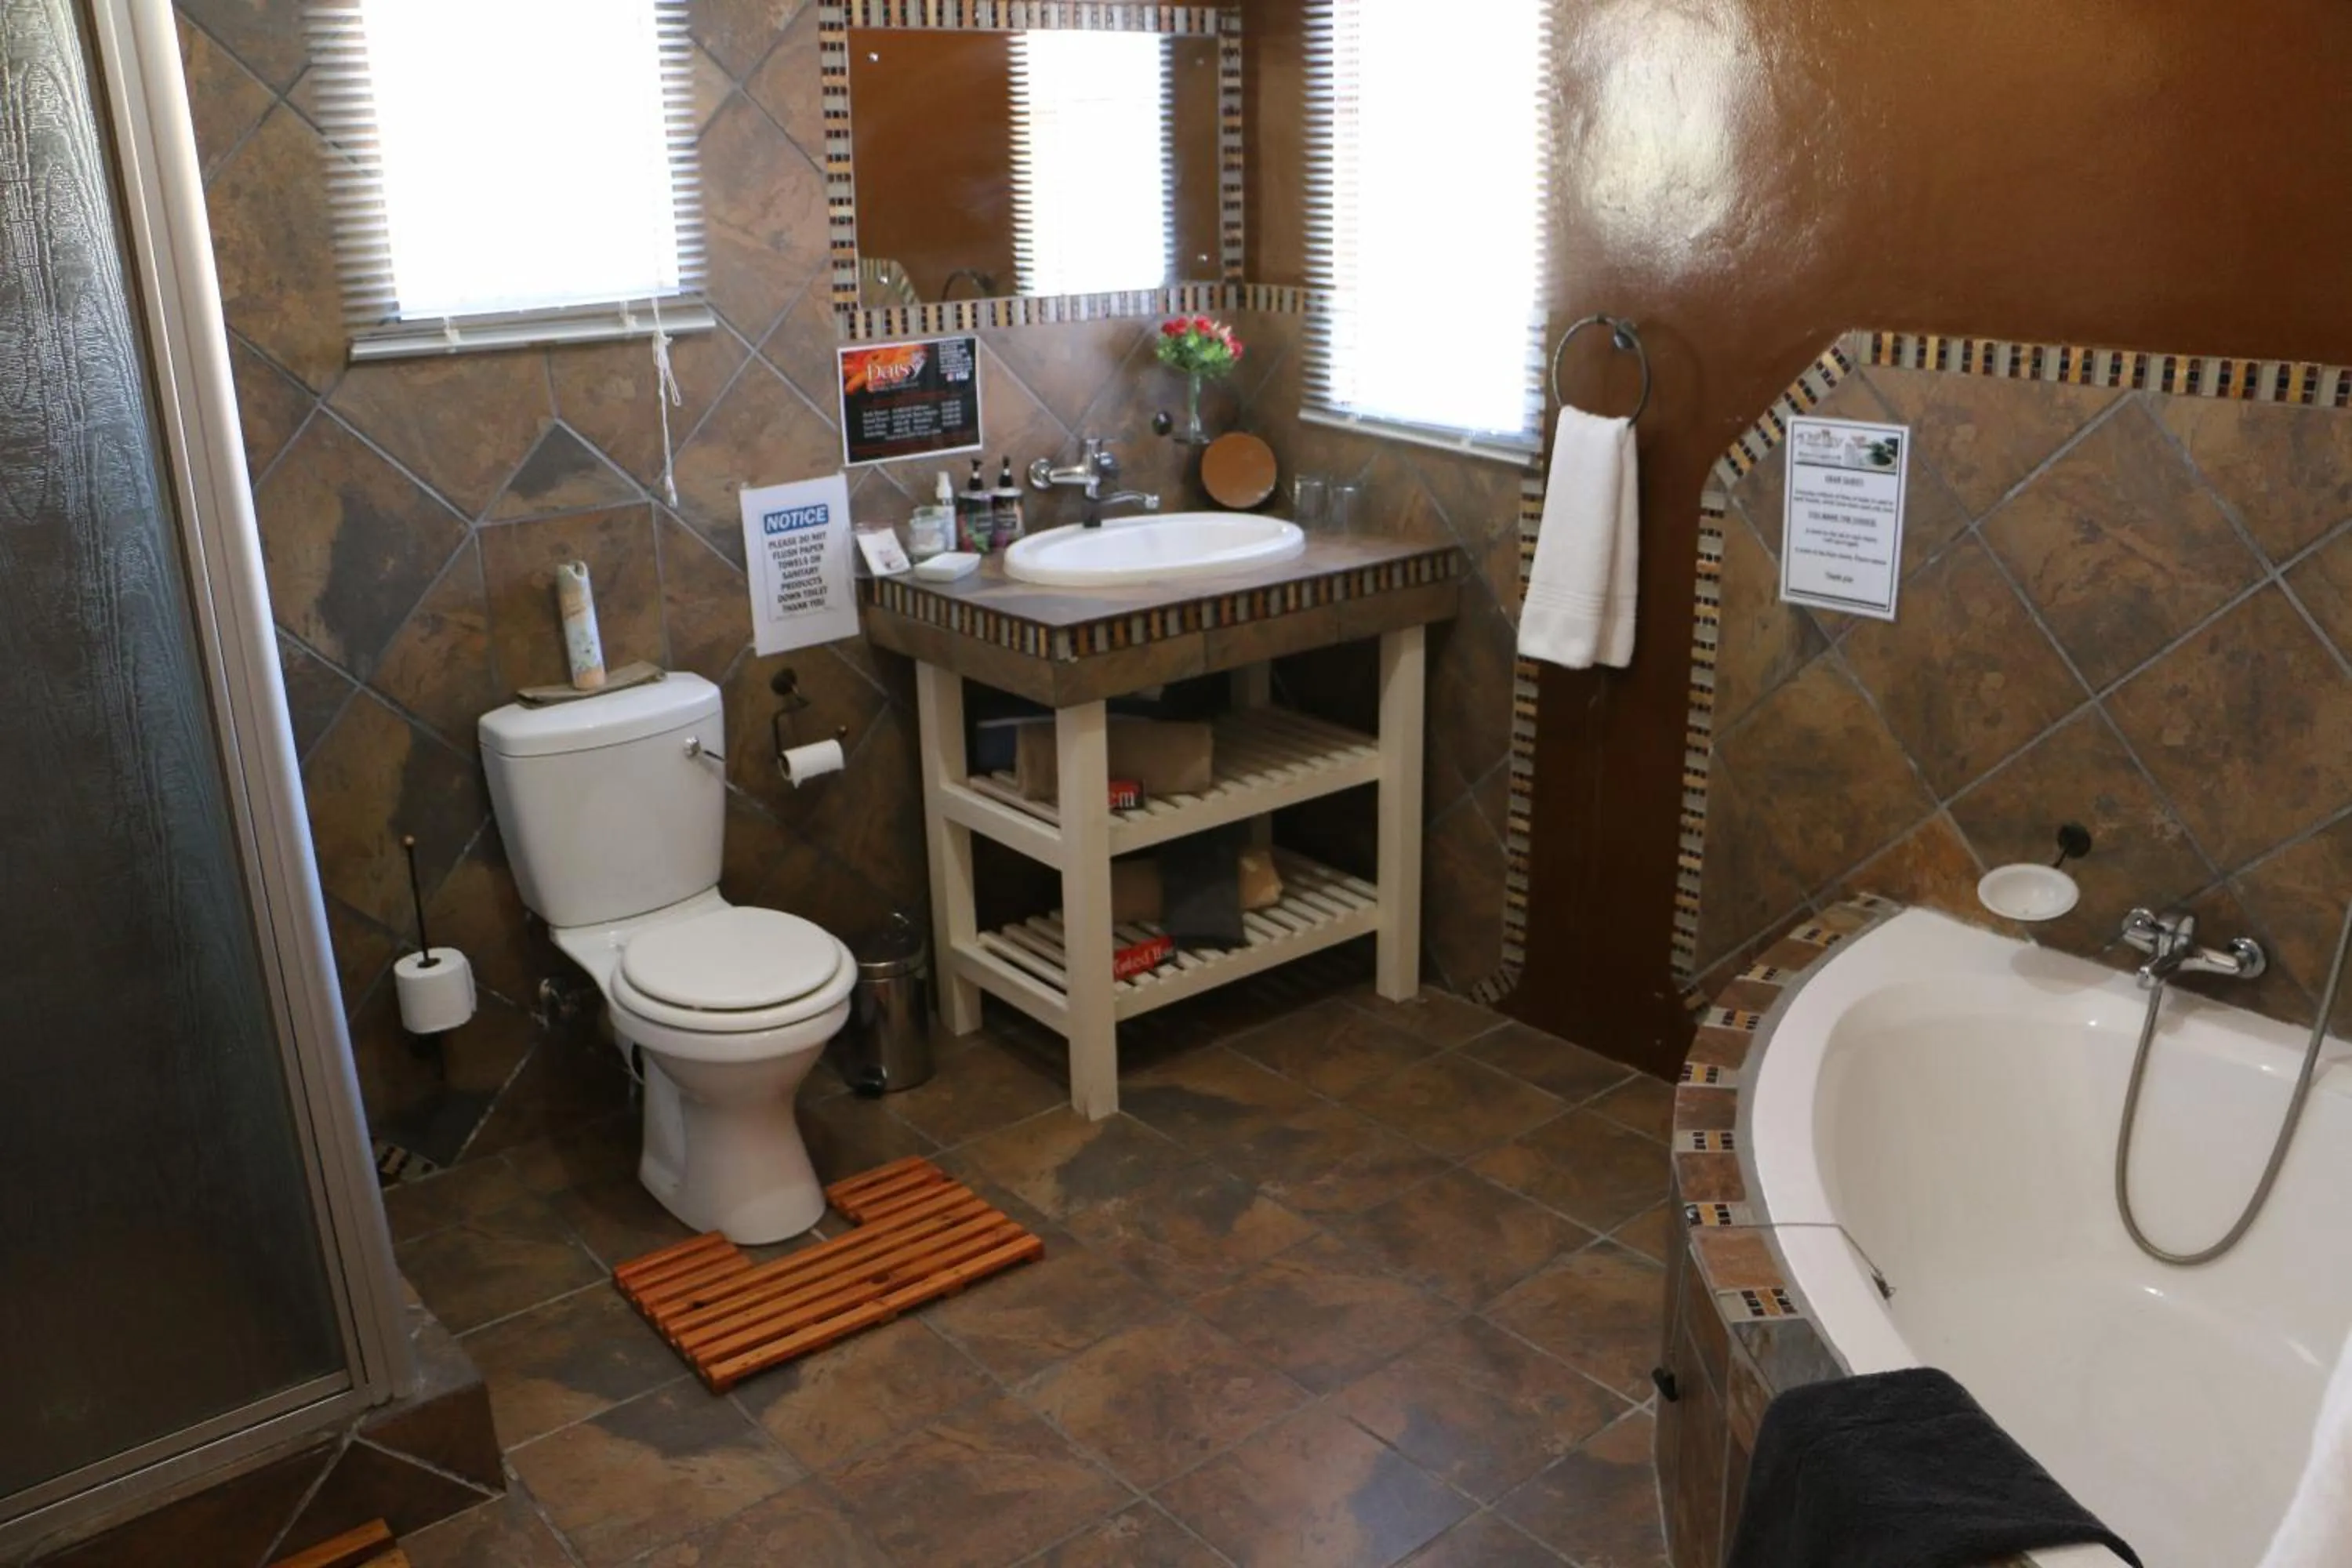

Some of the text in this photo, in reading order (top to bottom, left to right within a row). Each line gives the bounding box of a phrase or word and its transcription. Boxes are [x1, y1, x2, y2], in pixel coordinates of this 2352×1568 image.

[766, 506, 827, 531] NOTICE
[768, 532, 826, 549] PLEASE DO NOT
[773, 544, 824, 560] FLUSH PAPER
[778, 557, 808, 570] TOWELS
[782, 567, 818, 580] SANITARY
[781, 577, 822, 590] PRODUCTS
[777, 587, 827, 603] DOWN TOILET
[782, 601, 808, 612] THANK
